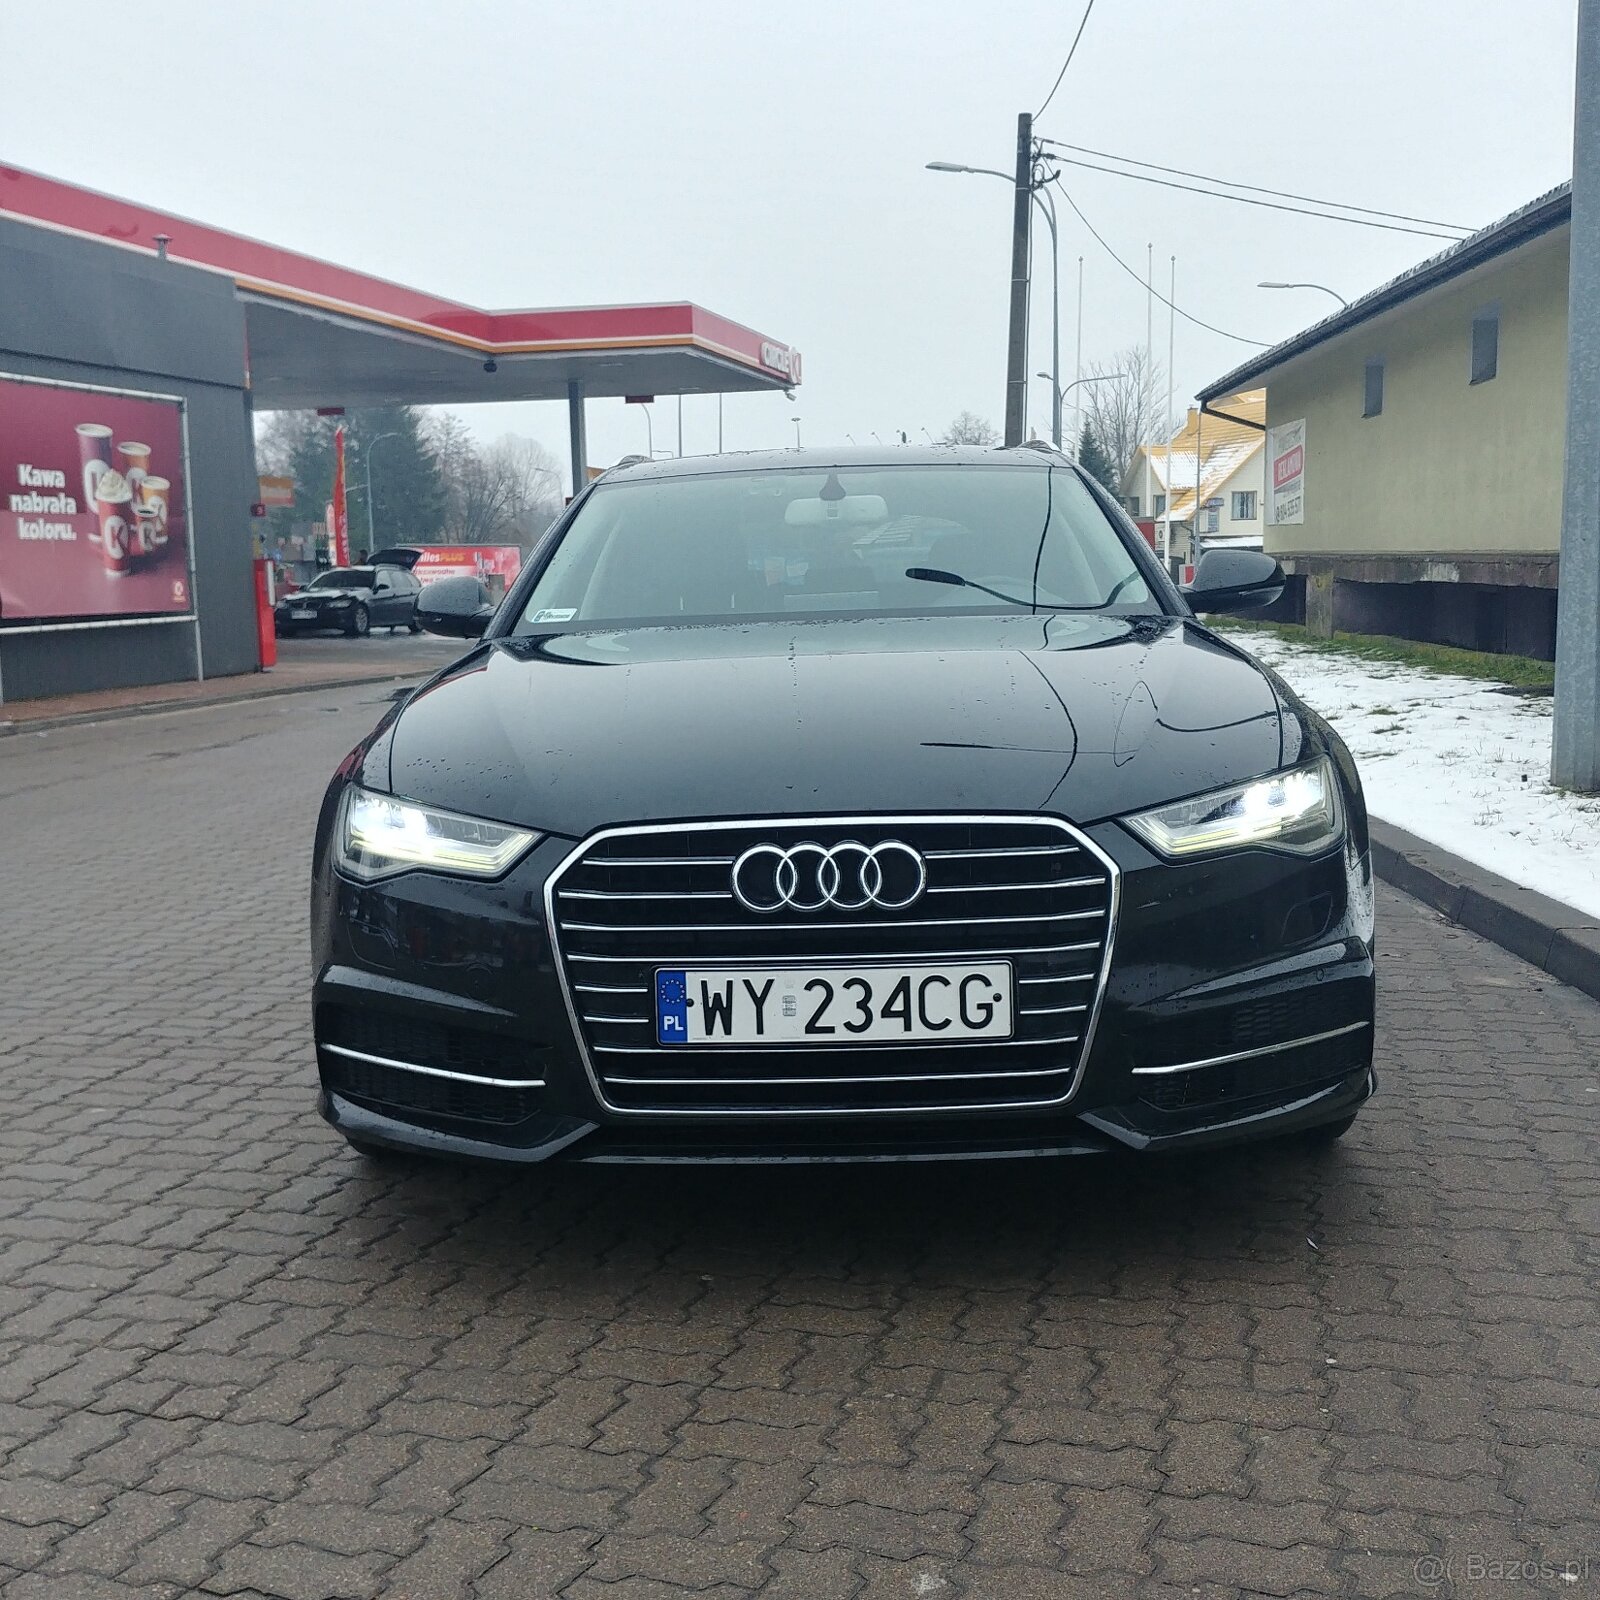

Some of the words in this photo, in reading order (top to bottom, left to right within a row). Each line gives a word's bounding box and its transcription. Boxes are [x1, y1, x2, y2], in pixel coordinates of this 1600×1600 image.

[17, 463, 66, 489] Kawa
[9, 490, 77, 515] nabrała
[17, 517, 77, 541] koloru.
[700, 978, 776, 1036] WY
[803, 972, 995, 1036] 234CG
[663, 1015, 685, 1031] PL
